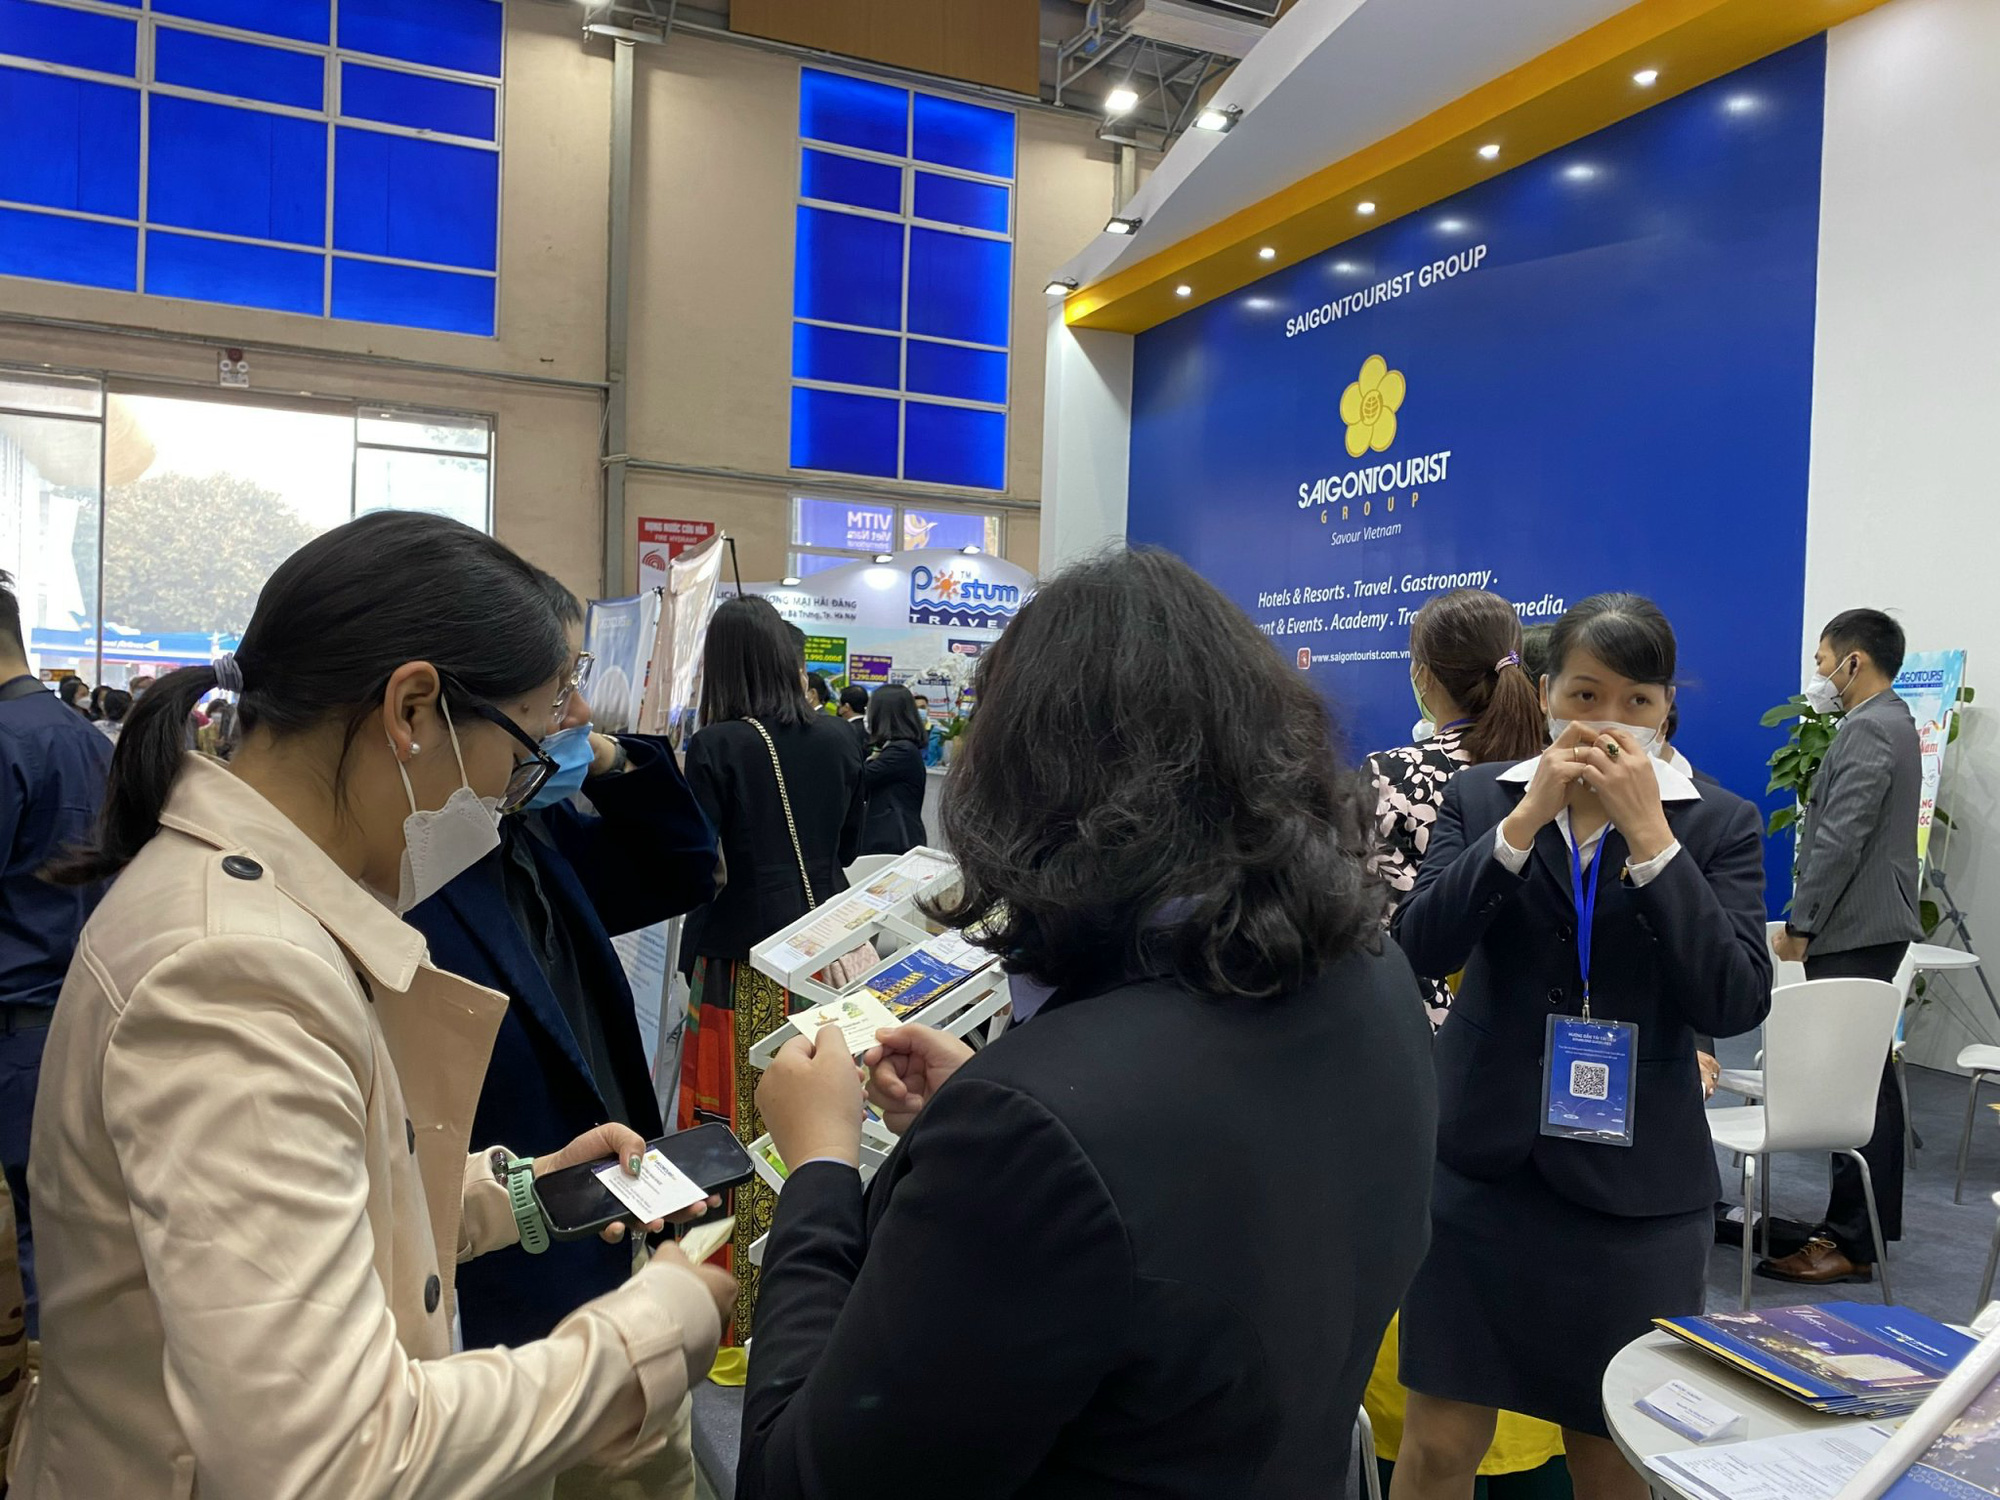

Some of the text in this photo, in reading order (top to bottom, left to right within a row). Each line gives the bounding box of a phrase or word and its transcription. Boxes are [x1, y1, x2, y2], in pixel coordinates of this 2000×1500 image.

[1286, 244, 1487, 337] SAIGONTOURIST GROUP
[1298, 451, 1451, 508] SAIGONTOURIST
[1321, 492, 1419, 524] GROUP
[1331, 523, 1402, 546] Savour Vietnam
[1258, 589, 1291, 608] Hotels
[1293, 588, 1301, 604] &
[1353, 575, 1393, 598] Travel
[1255, 619, 1275, 637] ent
[1276, 618, 1286, 635] &
[1286, 615, 1323, 635] Events
[1330, 610, 1388, 631] Academy
[1511, 594, 1567, 617] media.
[1312, 650, 1411, 664] www.saigontourist.com.vn
